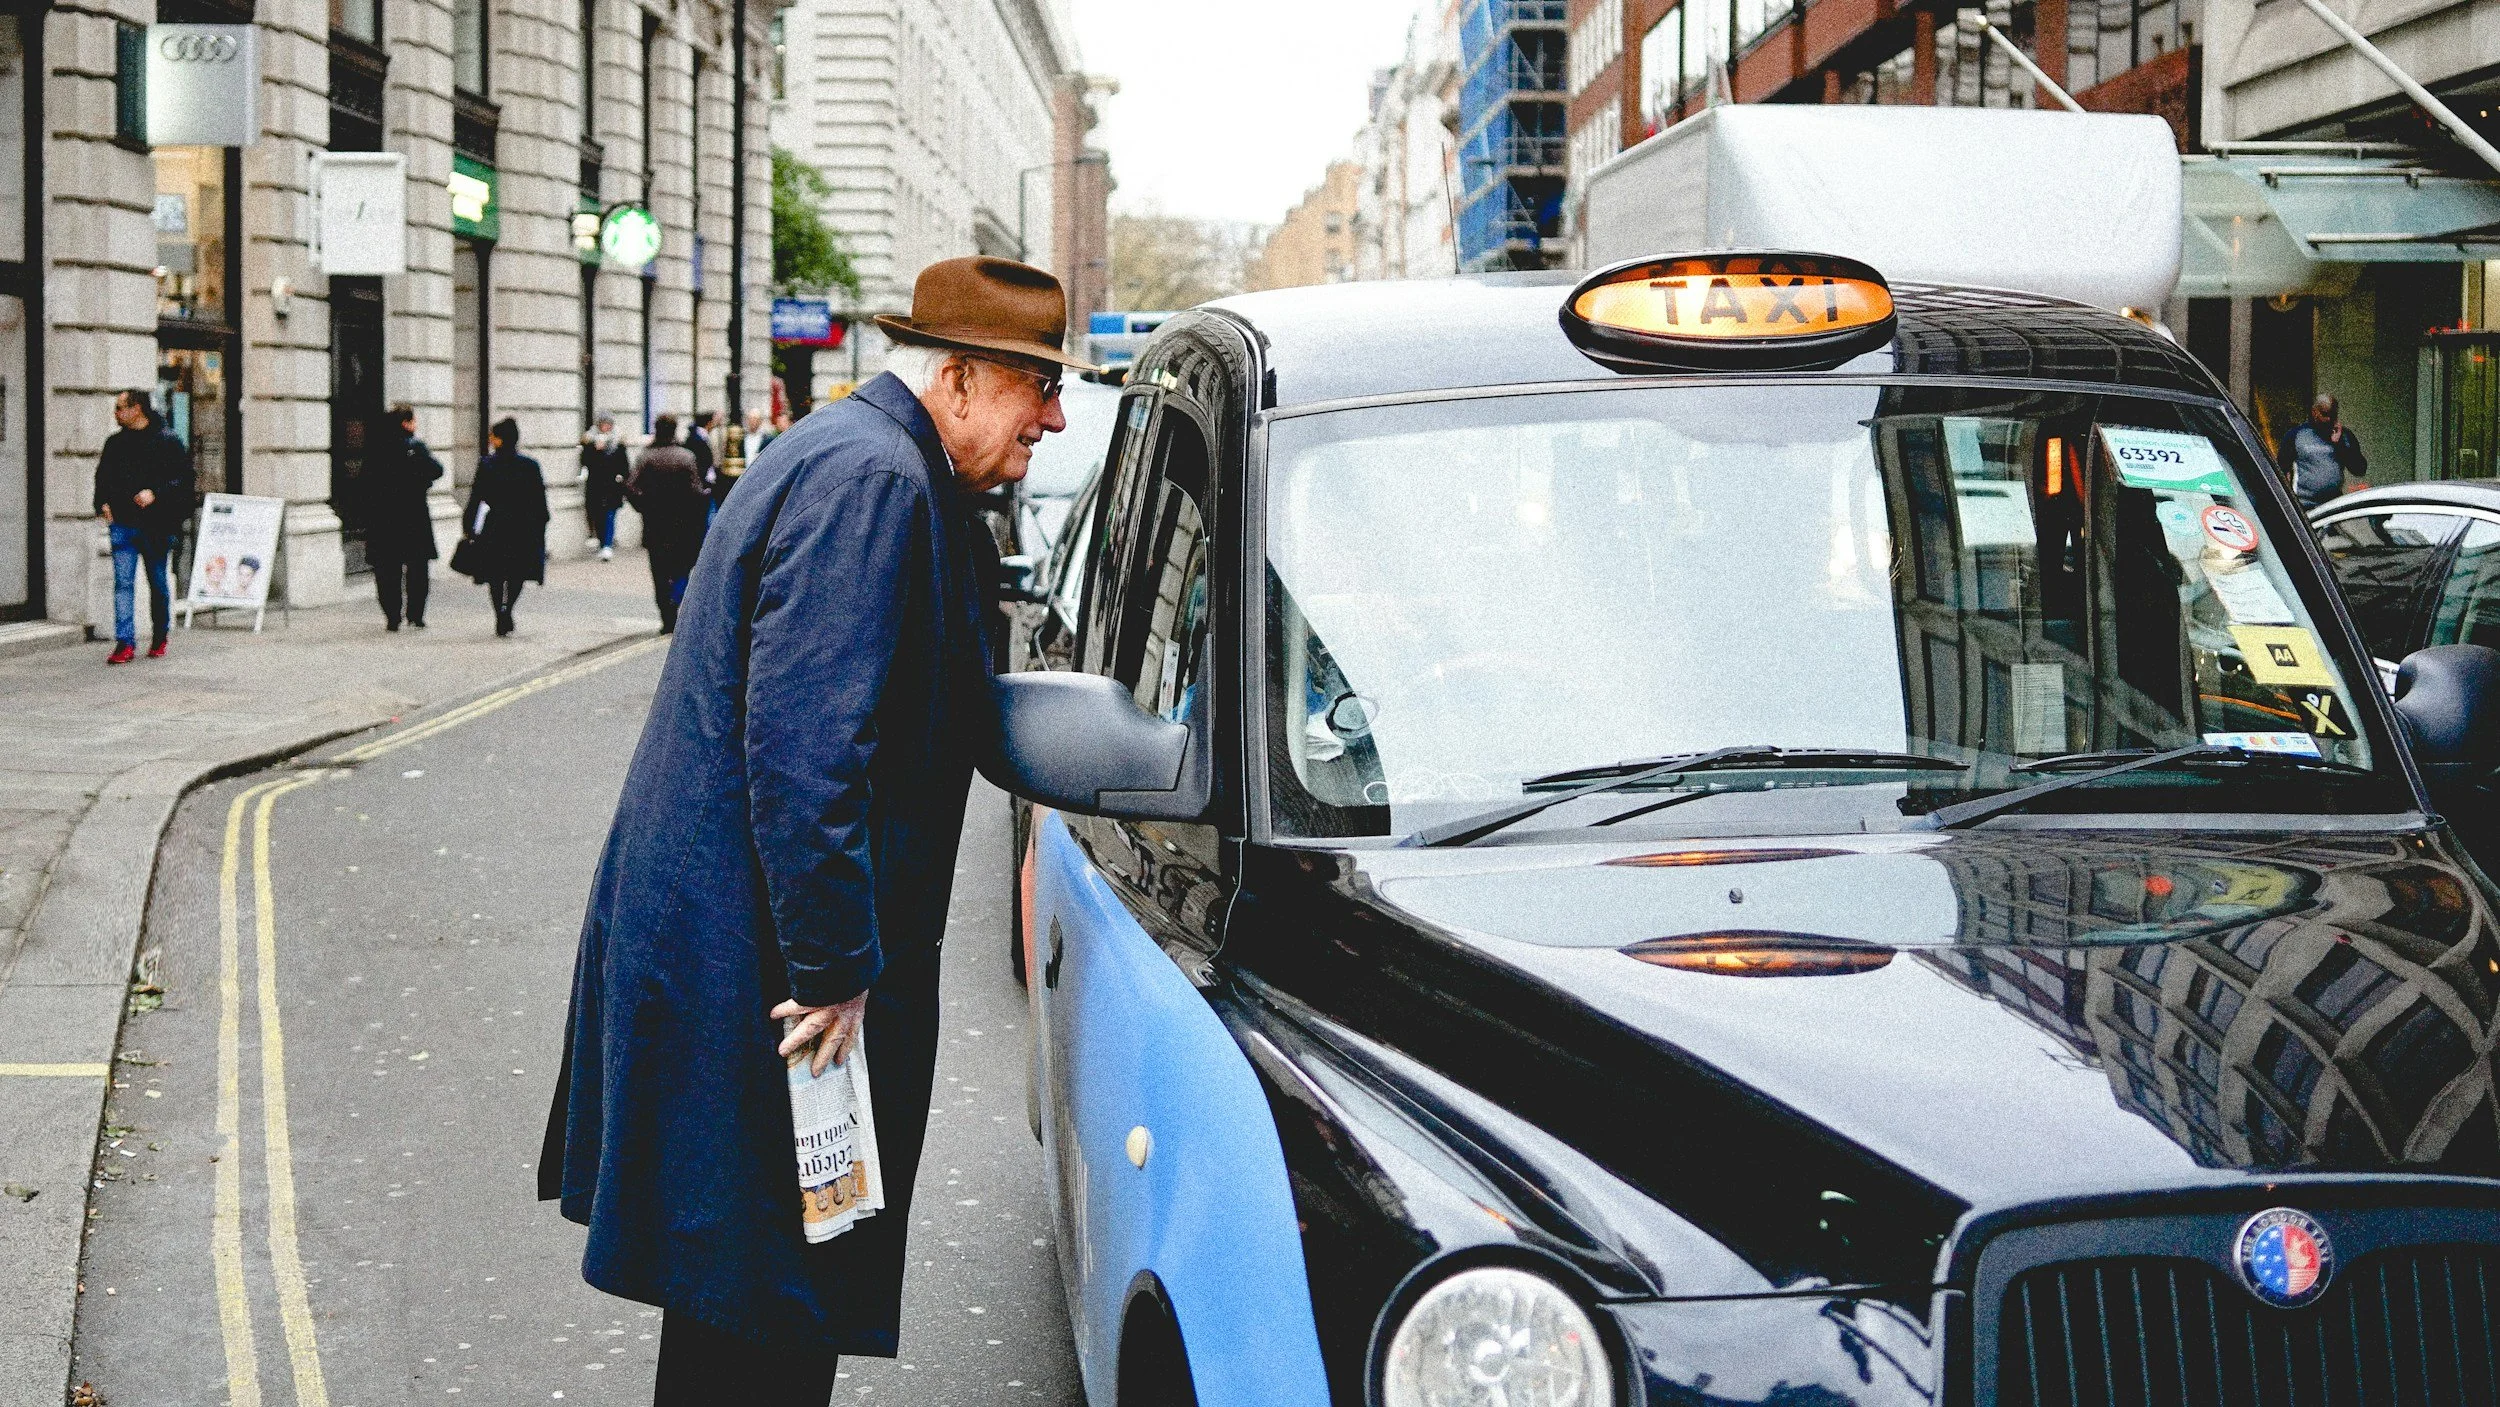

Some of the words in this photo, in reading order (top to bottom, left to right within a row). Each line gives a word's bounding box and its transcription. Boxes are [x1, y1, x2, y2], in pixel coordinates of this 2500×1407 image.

[1649, 277, 1839, 326] TAXI
[2119, 447, 2184, 464] 63392
[2273, 648, 2294, 663] AA
[2254, 1213, 2308, 1232] LONDON
